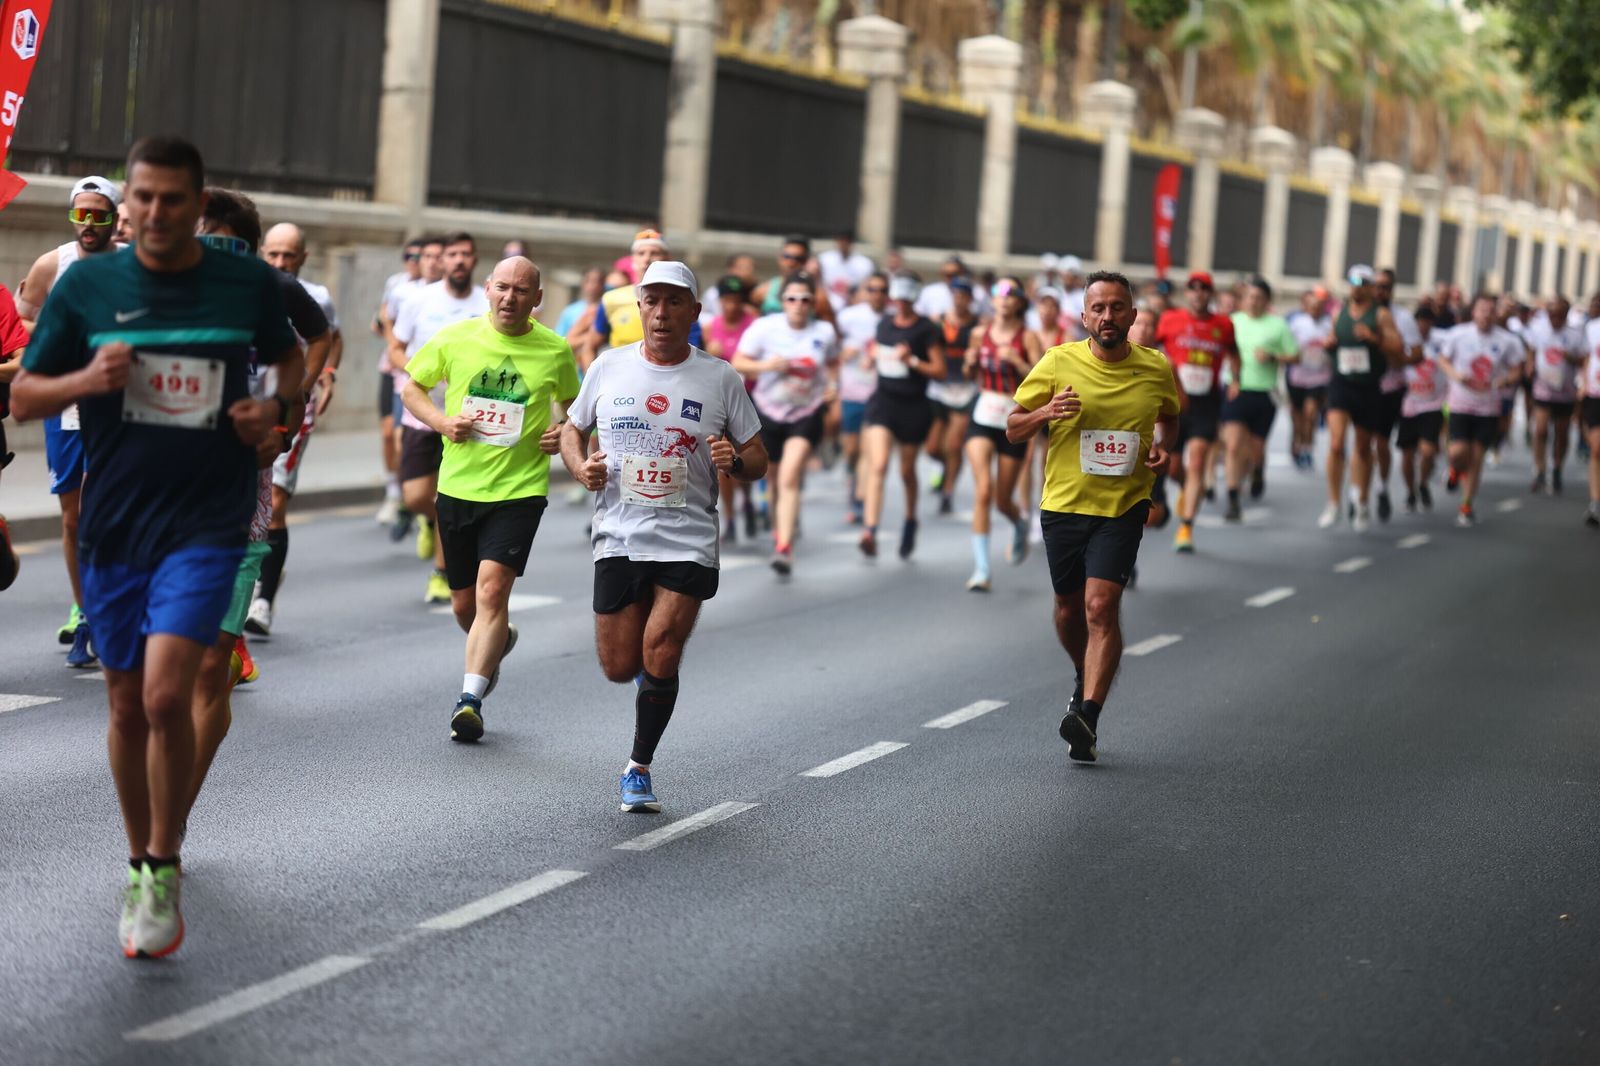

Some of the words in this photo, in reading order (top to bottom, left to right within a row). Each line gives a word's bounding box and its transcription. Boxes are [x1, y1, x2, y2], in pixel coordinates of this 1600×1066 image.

[475, 409, 507, 425] 271
[682, 405, 701, 418] AXA
[611, 422, 652, 430] VIRTUAL
[1094, 441, 1127, 455] 842
[636, 469, 672, 484] 175
